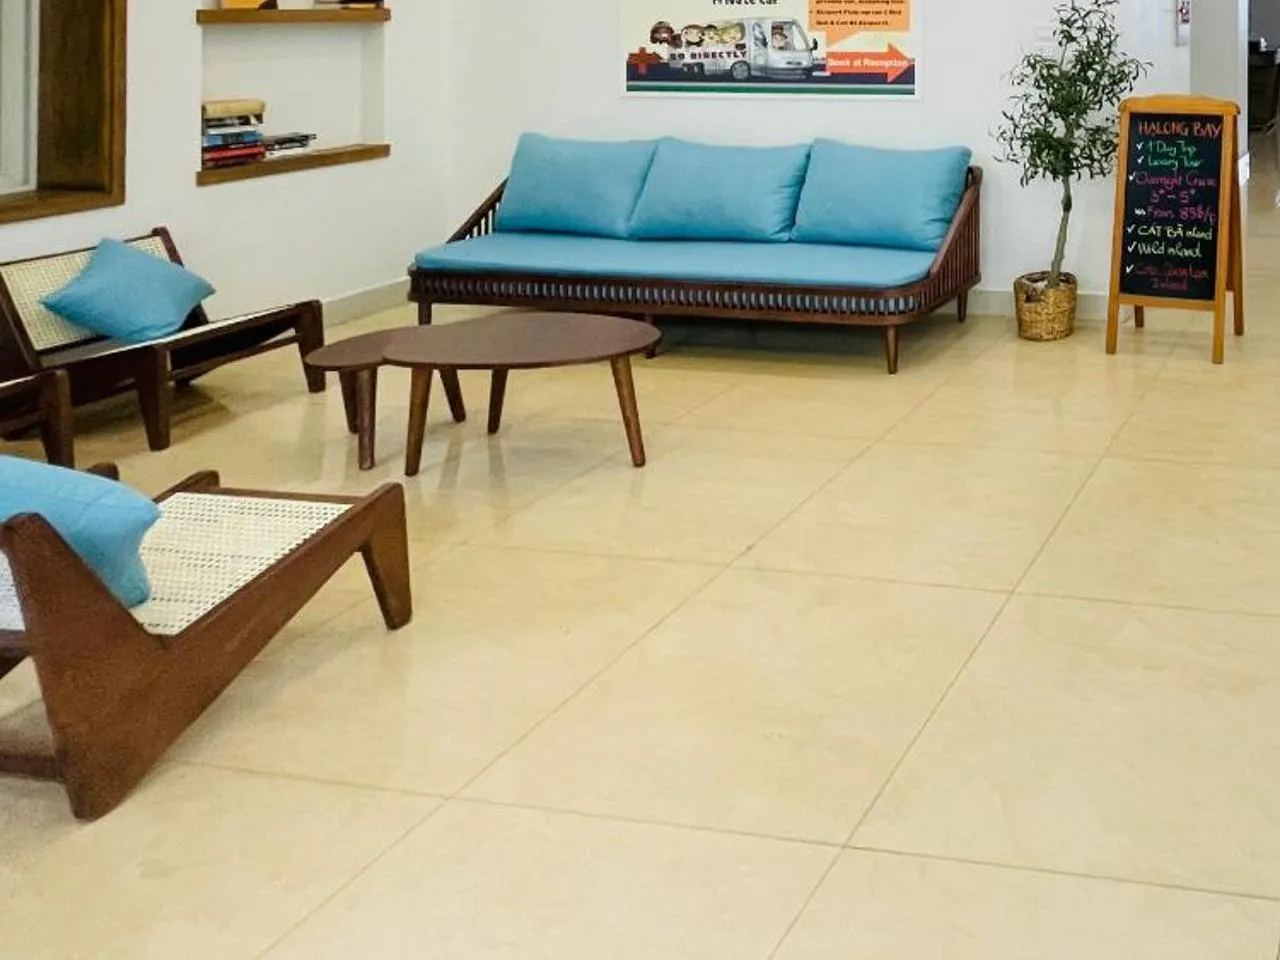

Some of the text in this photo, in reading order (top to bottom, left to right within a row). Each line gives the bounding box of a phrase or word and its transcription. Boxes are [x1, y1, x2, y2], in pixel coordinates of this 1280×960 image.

[1138, 121, 1221, 138] HALONG BAY
[1156, 140, 1177, 156] Day
